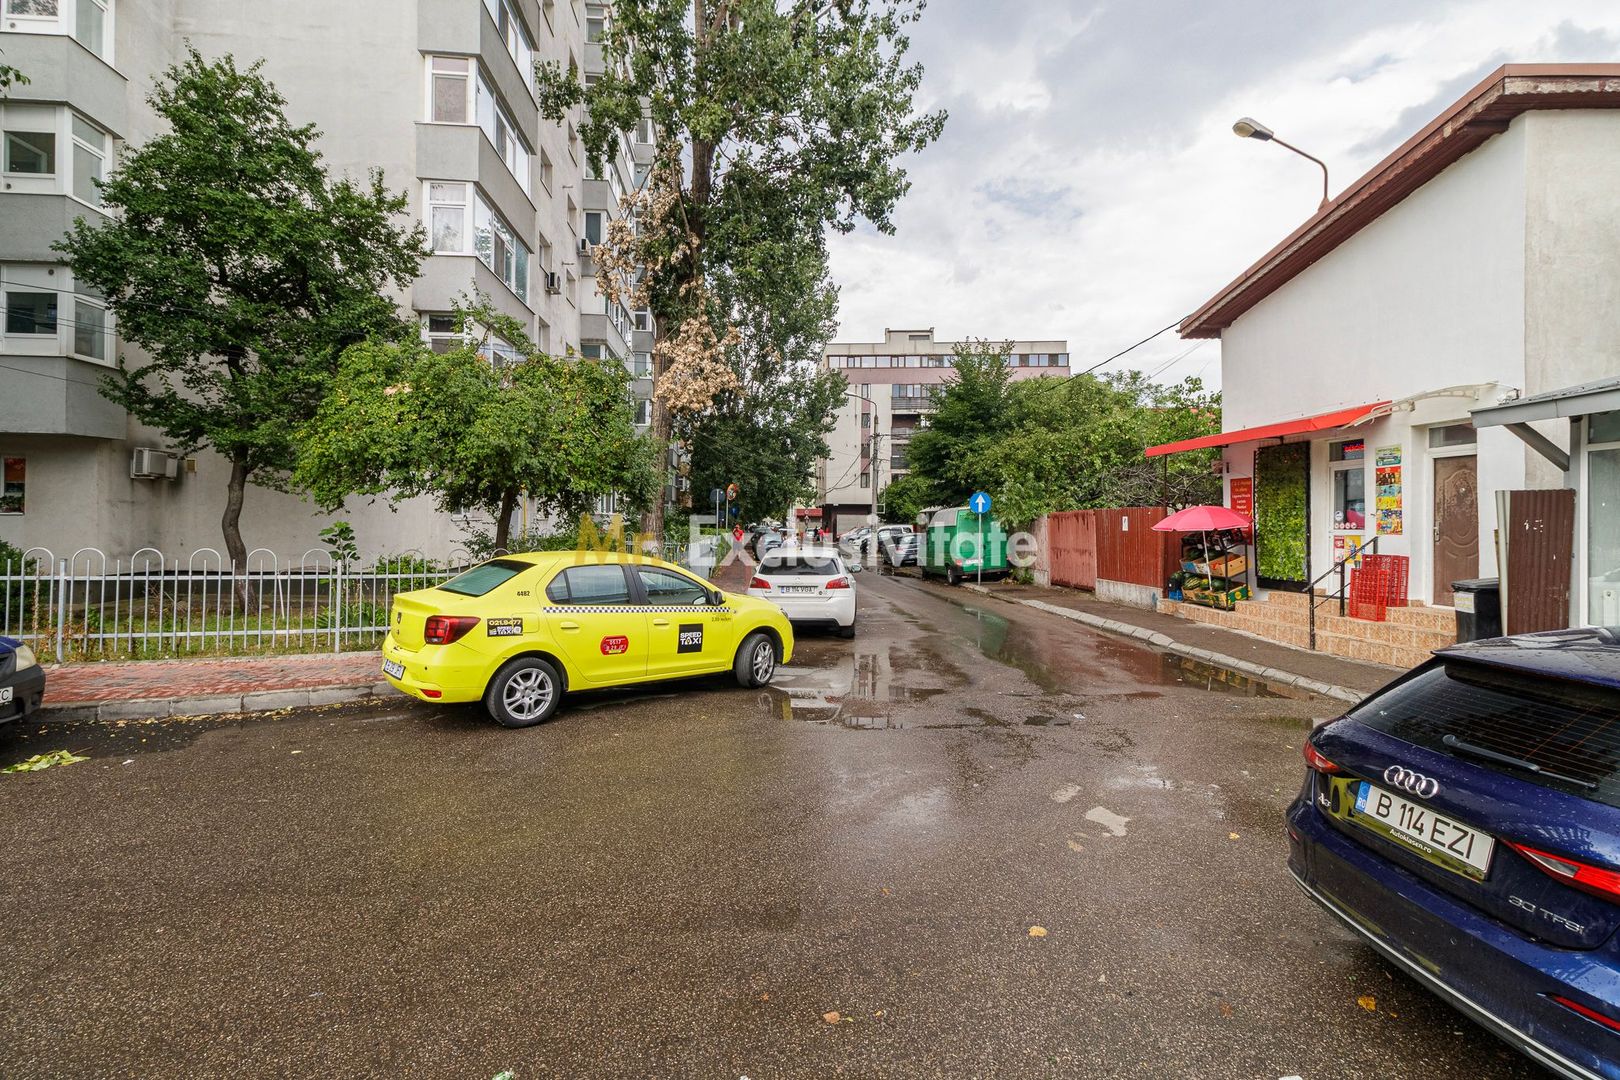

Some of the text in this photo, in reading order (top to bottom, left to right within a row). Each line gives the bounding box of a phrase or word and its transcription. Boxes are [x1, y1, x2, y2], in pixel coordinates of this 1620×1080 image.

[680, 631, 702, 639] SPEED
[680, 637, 702, 645] TAXI
[1375, 793, 1475, 860] B 114 EZI
[1389, 828, 1433, 855] Autoklasen.ro
[1508, 895, 1536, 913] 30
